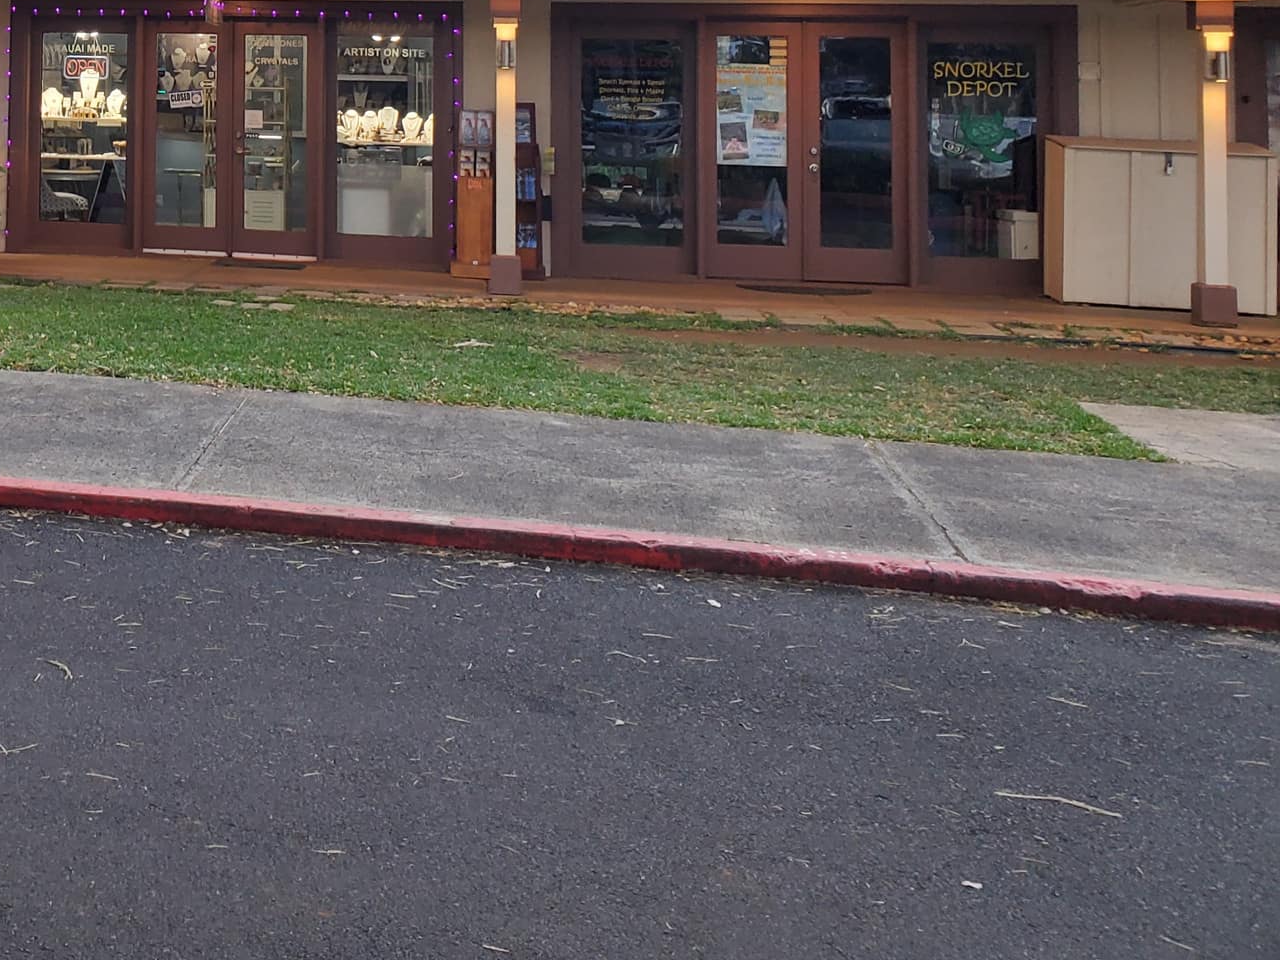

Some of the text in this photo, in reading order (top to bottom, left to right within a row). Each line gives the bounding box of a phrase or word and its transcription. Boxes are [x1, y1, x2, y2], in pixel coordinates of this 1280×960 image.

[86, 44, 116, 53] MADE
[343, 47, 425, 58] ARTIST ON SITE
[933, 61, 1030, 79] SNORKEL
[947, 80, 1018, 97] DEPOT
[170, 92, 191, 102] CLOSED
